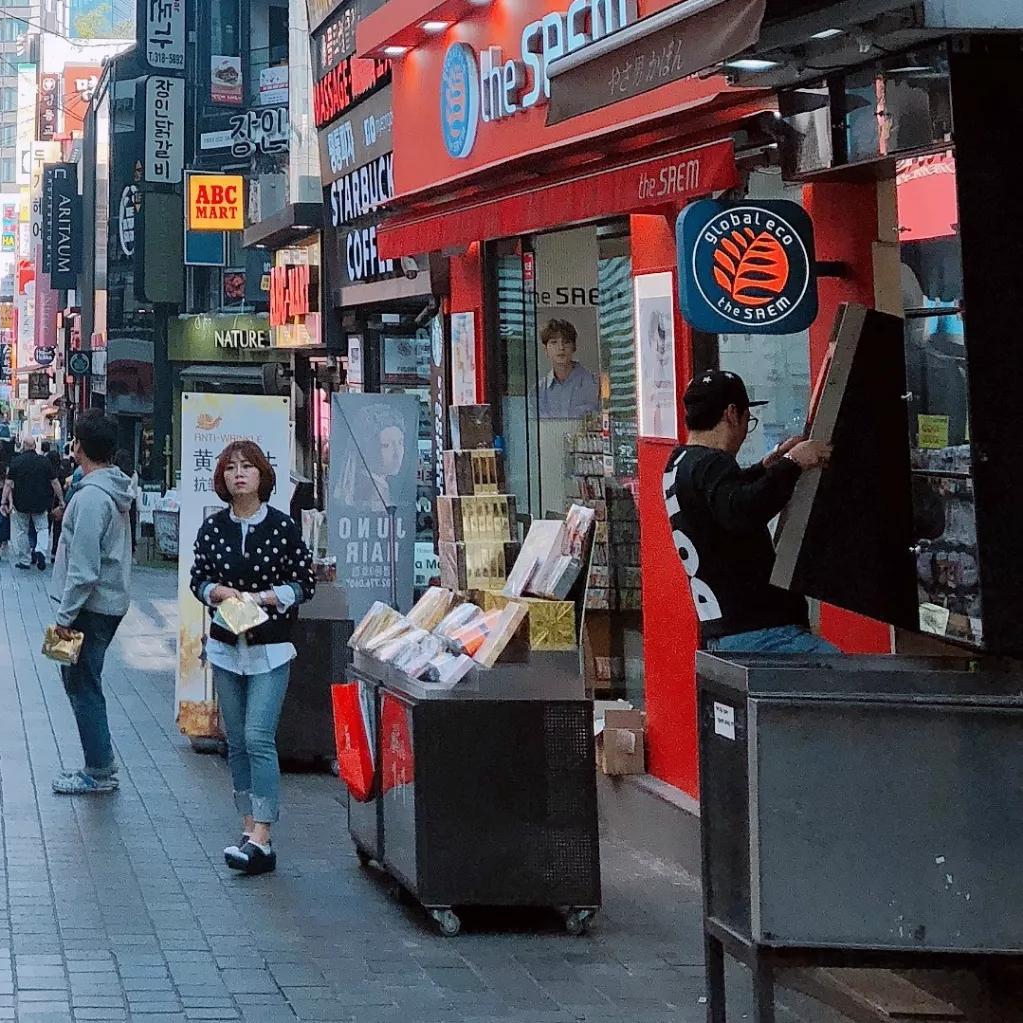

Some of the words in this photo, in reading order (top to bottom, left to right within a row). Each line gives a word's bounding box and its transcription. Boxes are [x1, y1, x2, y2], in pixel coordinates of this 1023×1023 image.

[479, 46, 516, 122] the
[195, 184, 238, 205] ABC
[638, 173, 656, 200] the
[195, 206, 238, 219] MART
[57, 193, 71, 272] ARITAUM
[703, 211, 761, 245] global
[765, 218, 794, 245] eco
[717, 296, 741, 318] the
[214, 330, 265, 349] NATURE
